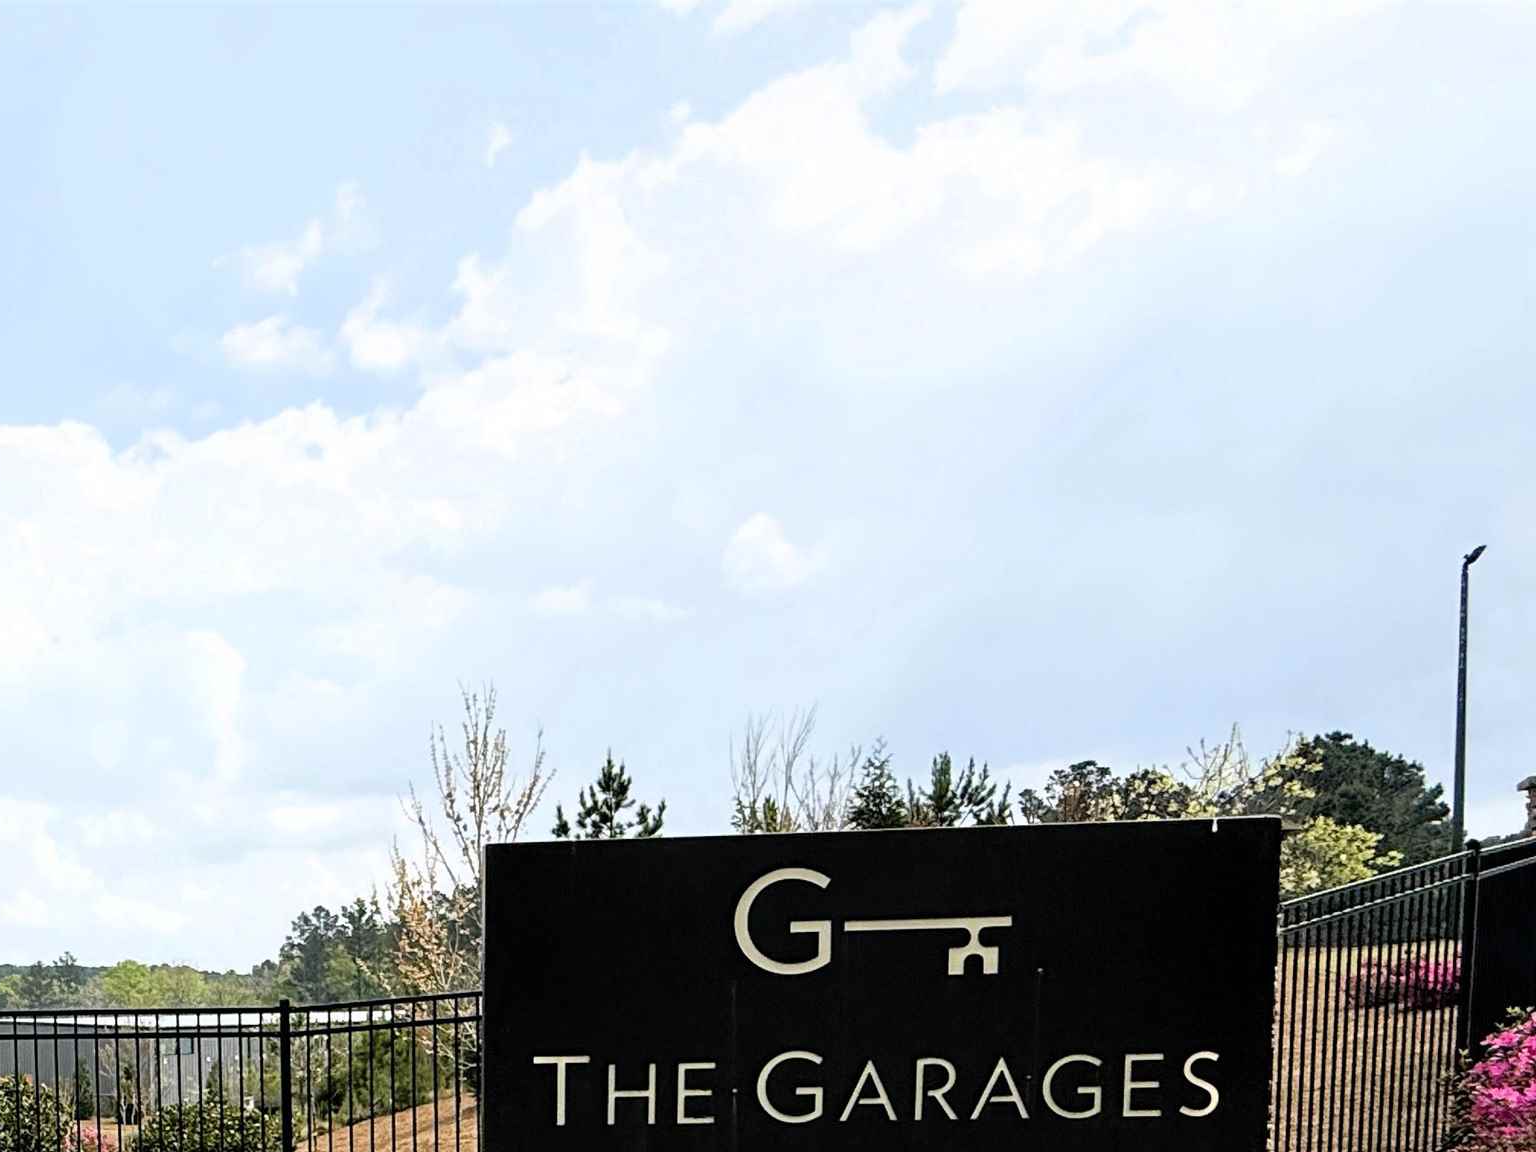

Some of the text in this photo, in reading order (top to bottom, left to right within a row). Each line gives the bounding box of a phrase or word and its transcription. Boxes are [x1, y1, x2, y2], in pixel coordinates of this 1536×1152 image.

[733, 867, 832, 975] G
[533, 1050, 1220, 1126] THE GARAGES
